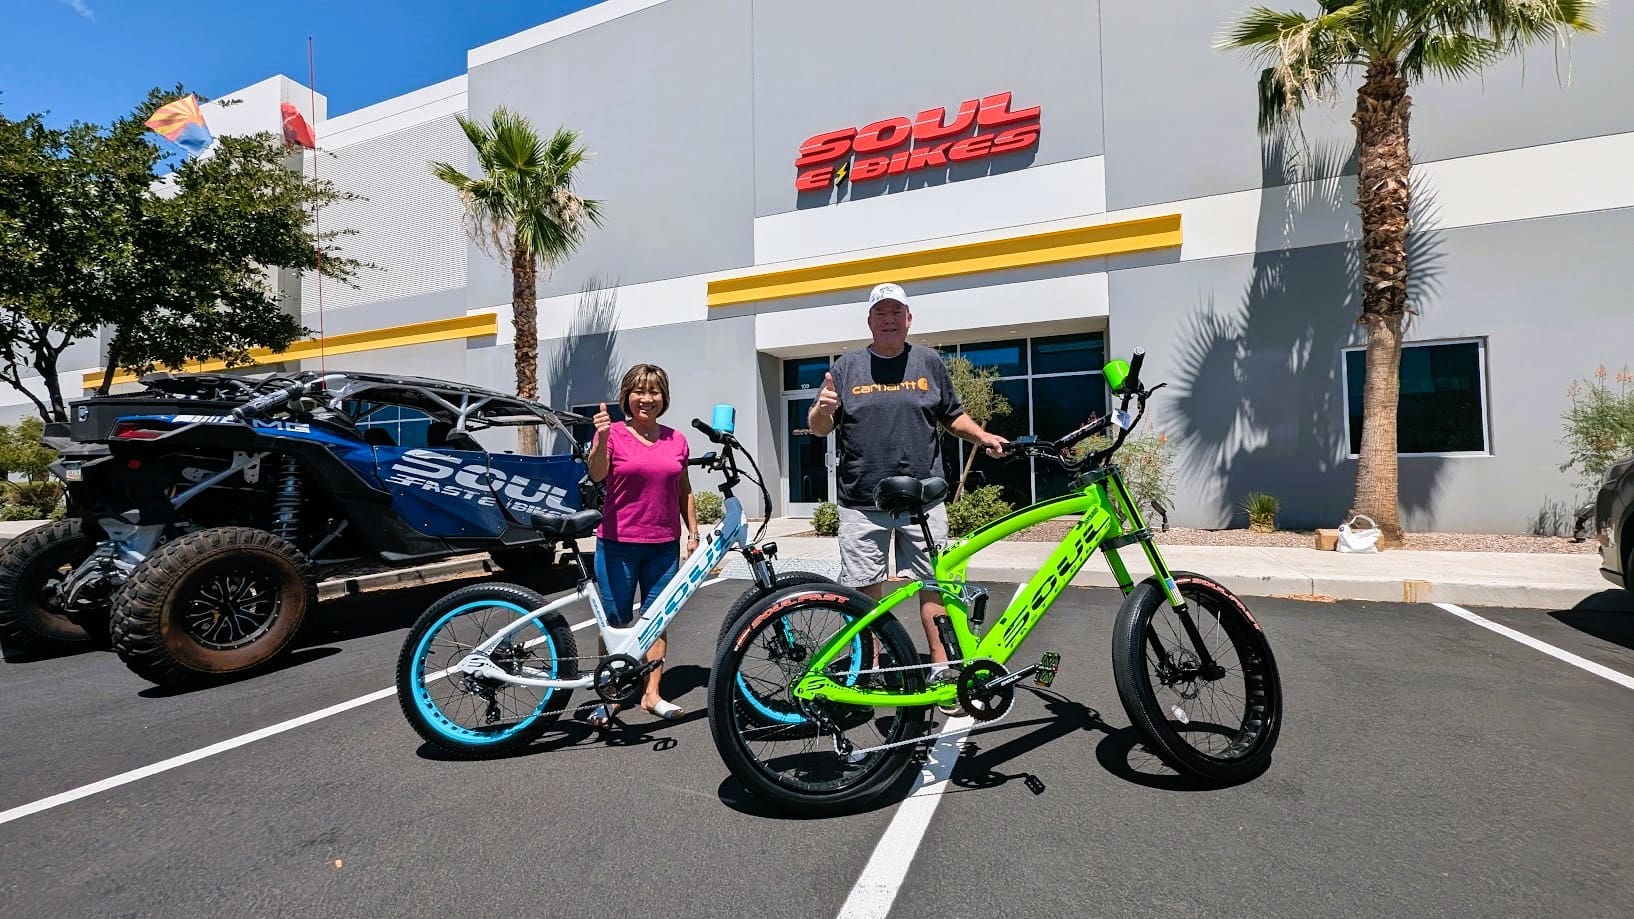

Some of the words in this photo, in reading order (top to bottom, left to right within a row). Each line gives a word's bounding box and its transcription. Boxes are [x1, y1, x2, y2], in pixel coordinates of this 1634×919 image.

[795, 91, 1041, 169] SOUL
[795, 166, 834, 192] E
[849, 123, 1041, 182] BIKES
[851, 381, 917, 396] carhartt
[385, 473, 481, 501] FAST
[391, 449, 577, 514] SOUL
[638, 524, 740, 651] SOUL
[751, 598, 798, 630] SOUL
[797, 593, 850, 606] FAST
[1003, 516, 1110, 649] SOUL
